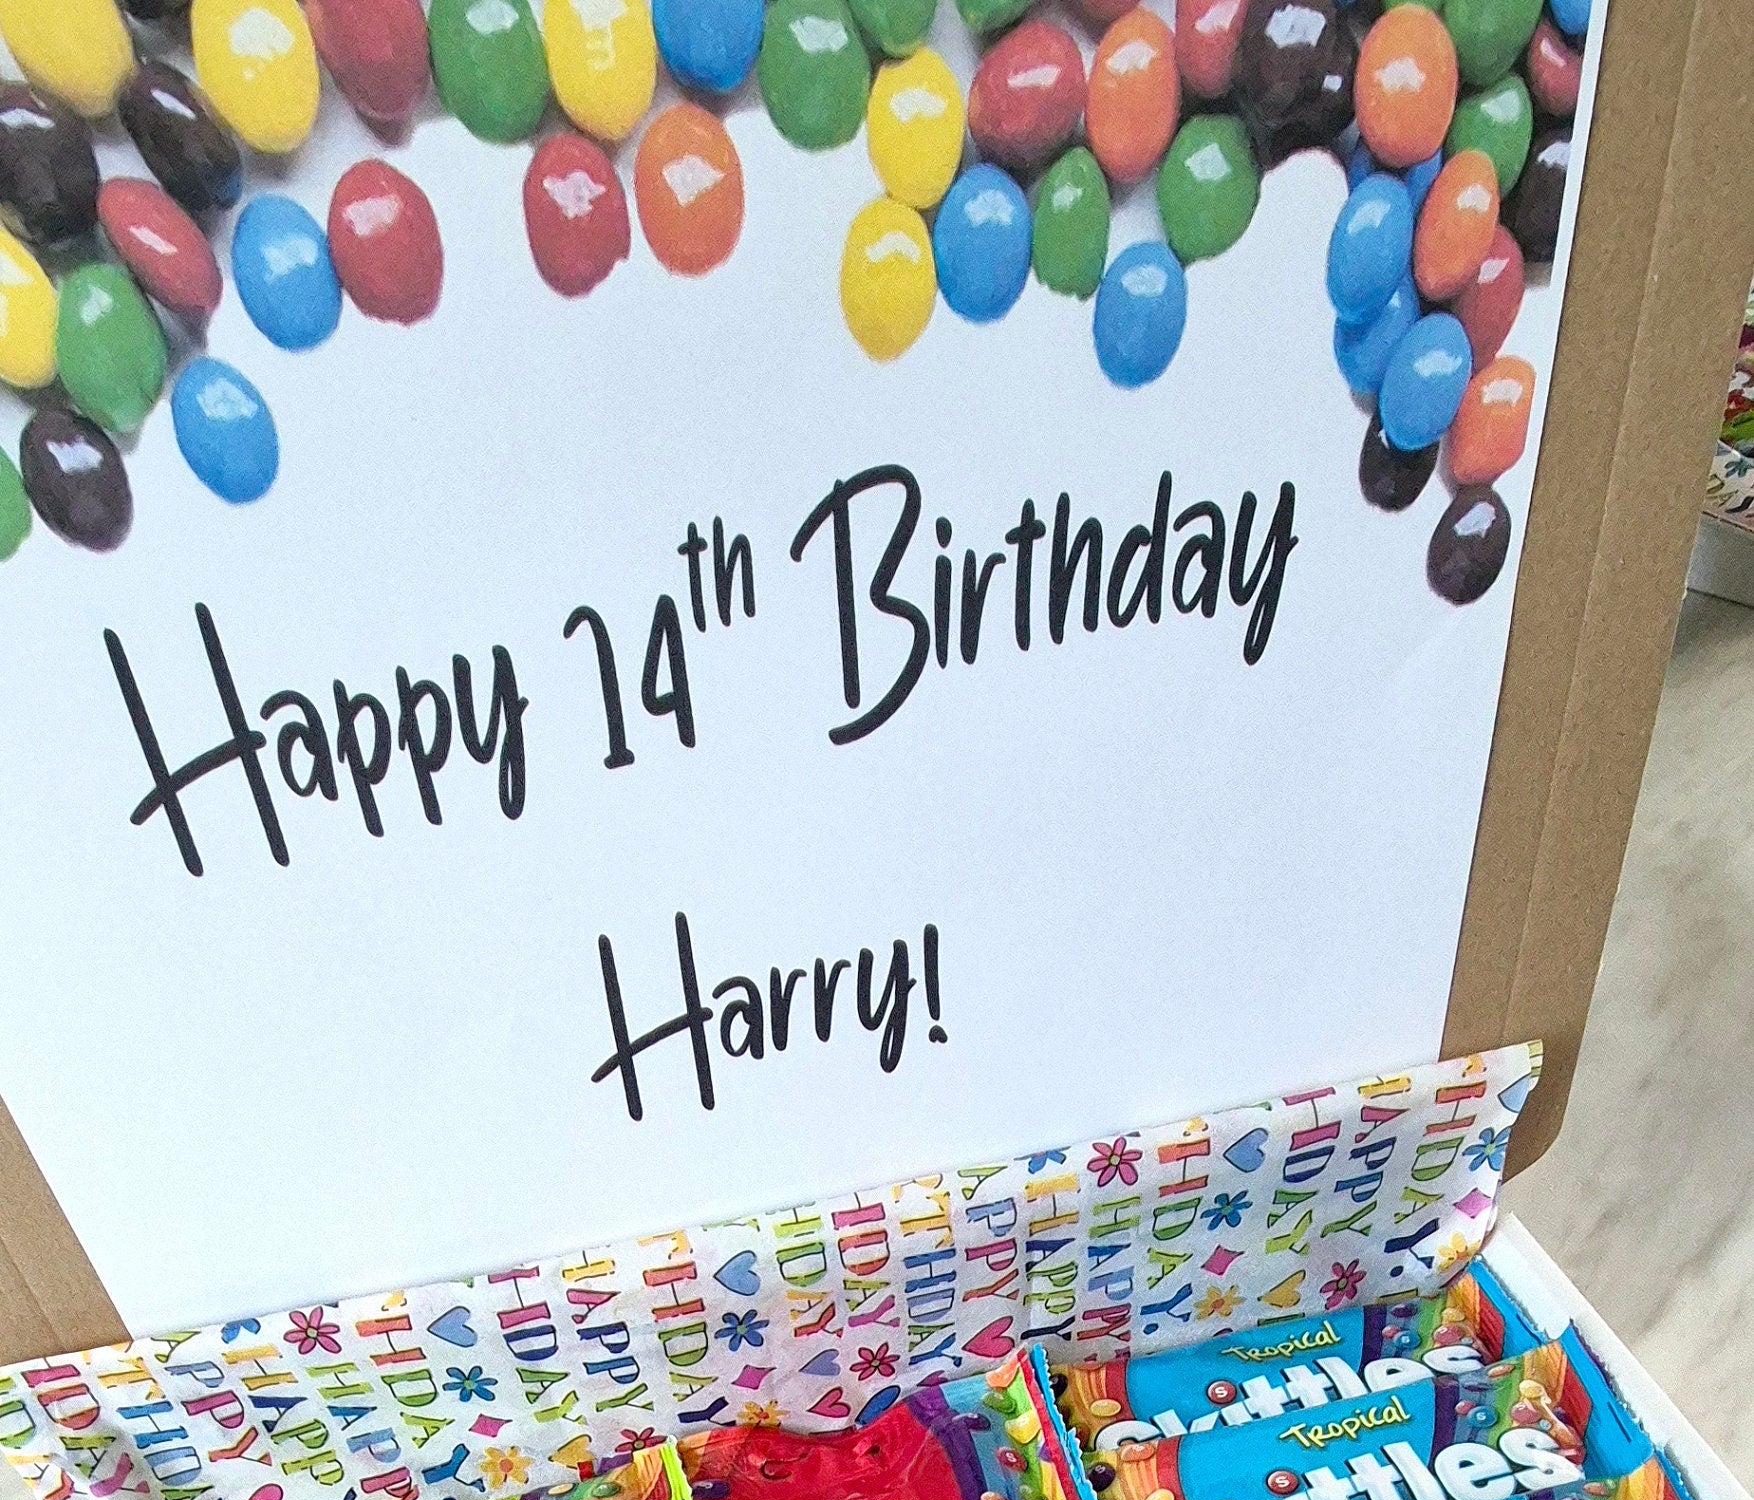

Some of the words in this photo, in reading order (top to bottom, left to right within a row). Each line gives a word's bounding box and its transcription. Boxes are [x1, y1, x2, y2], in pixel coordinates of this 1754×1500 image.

[104, 602, 528, 876] Happy
[563, 515, 757, 769] 14th
[790, 463, 1299, 745] Birthday
[592, 912, 948, 1120] Harry!
[1021, 1172, 1081, 1341] HAPPY
[1077, 1196, 1141, 1342] HAPPY
[1280, 1399, 1411, 1449] Tropical
